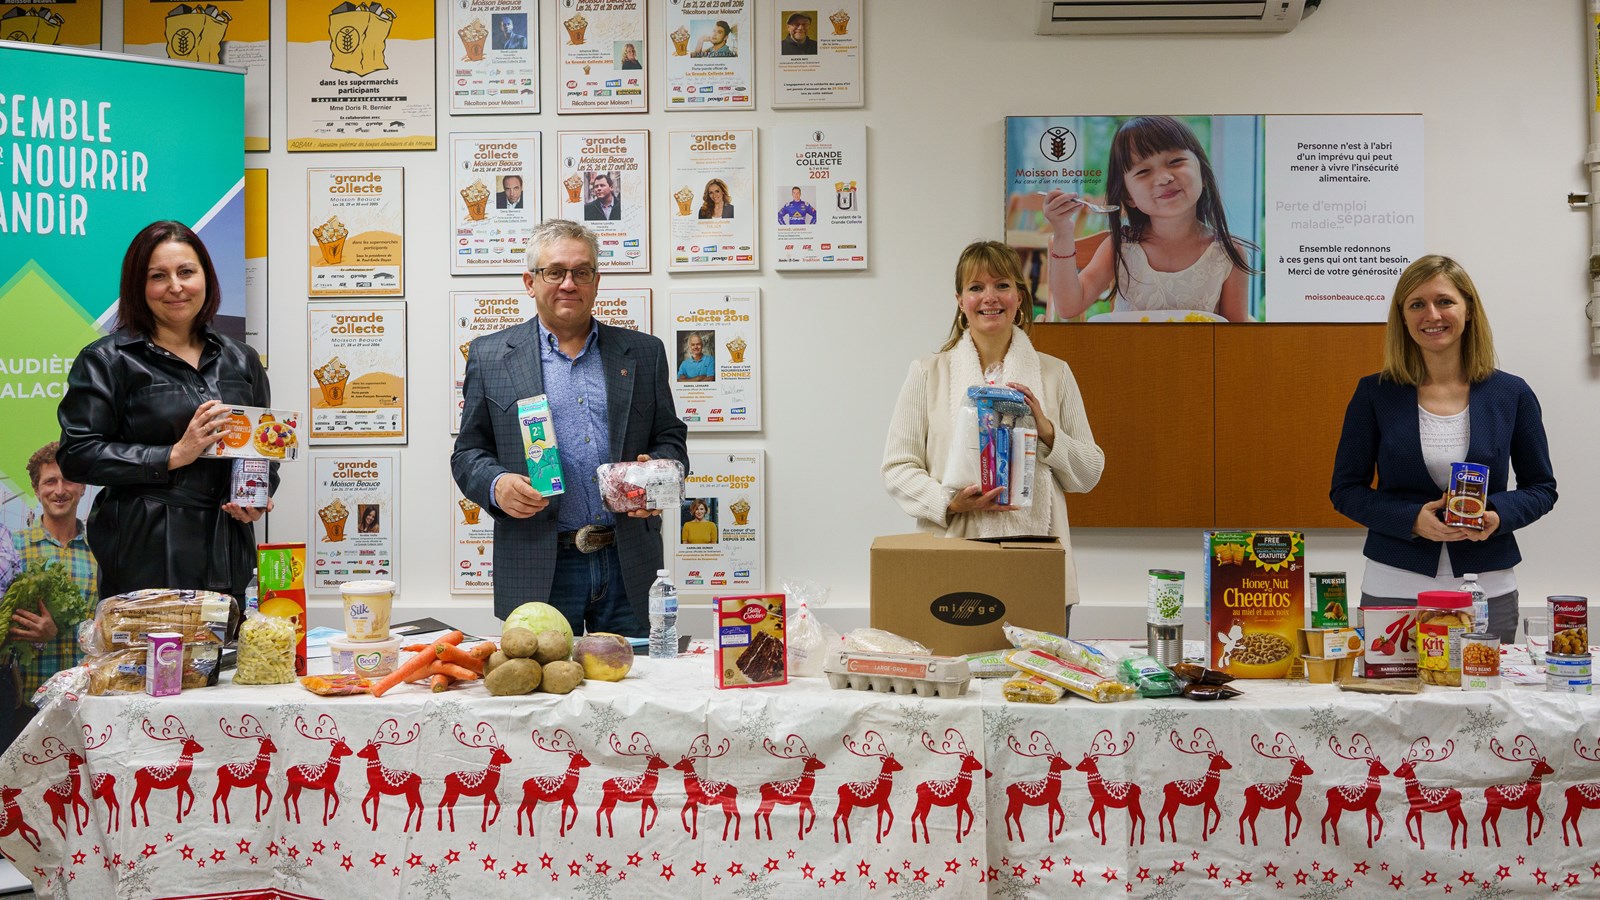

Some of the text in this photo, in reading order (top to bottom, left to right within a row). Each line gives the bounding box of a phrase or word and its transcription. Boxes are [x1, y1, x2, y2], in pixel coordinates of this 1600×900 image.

[350, 78, 398, 86] supermarchés
[586, 136, 626, 146] grande
[695, 132, 735, 143] grande
[479, 142, 517, 152] grande
[581, 145, 627, 154] collecte
[690, 142, 736, 151] collecte
[474, 150, 518, 159] collecte
[1318, 153, 1354, 162] imprévu
[1356, 153, 1370, 161] qui
[809, 171, 830, 179] 2021
[1016, 168, 1102, 177] Moisson Beauce
[335, 172, 381, 184] grande
[329, 183, 382, 193] collecte
[1276, 201, 1367, 213] Perte d'emploi
[1337, 211, 1414, 226] séparation
[1291, 220, 1344, 229] maladie...
[1304, 257, 1324, 265] gens
[1327, 256, 1340, 265] qui
[1352, 267, 1398, 277] générosité
[479, 298, 518, 307] grande
[596, 298, 627, 306] rande
[474, 306, 520, 315] collecte
[591, 307, 628, 315] ollecte
[336, 312, 384, 324] grande
[330, 324, 385, 334] collecte
[338, 460, 377, 470] grande
[333, 469, 378, 478] collecte
[1458, 473, 1484, 482] CATELLI
[1242, 579, 1288, 590] Honey Nut
[1224, 588, 1290, 607] Cheerios
[350, 604, 369, 617] Silk
[938, 603, 996, 614] mirage
[1422, 638, 1444, 650] Krit
[360, 656, 378, 665] Becel
